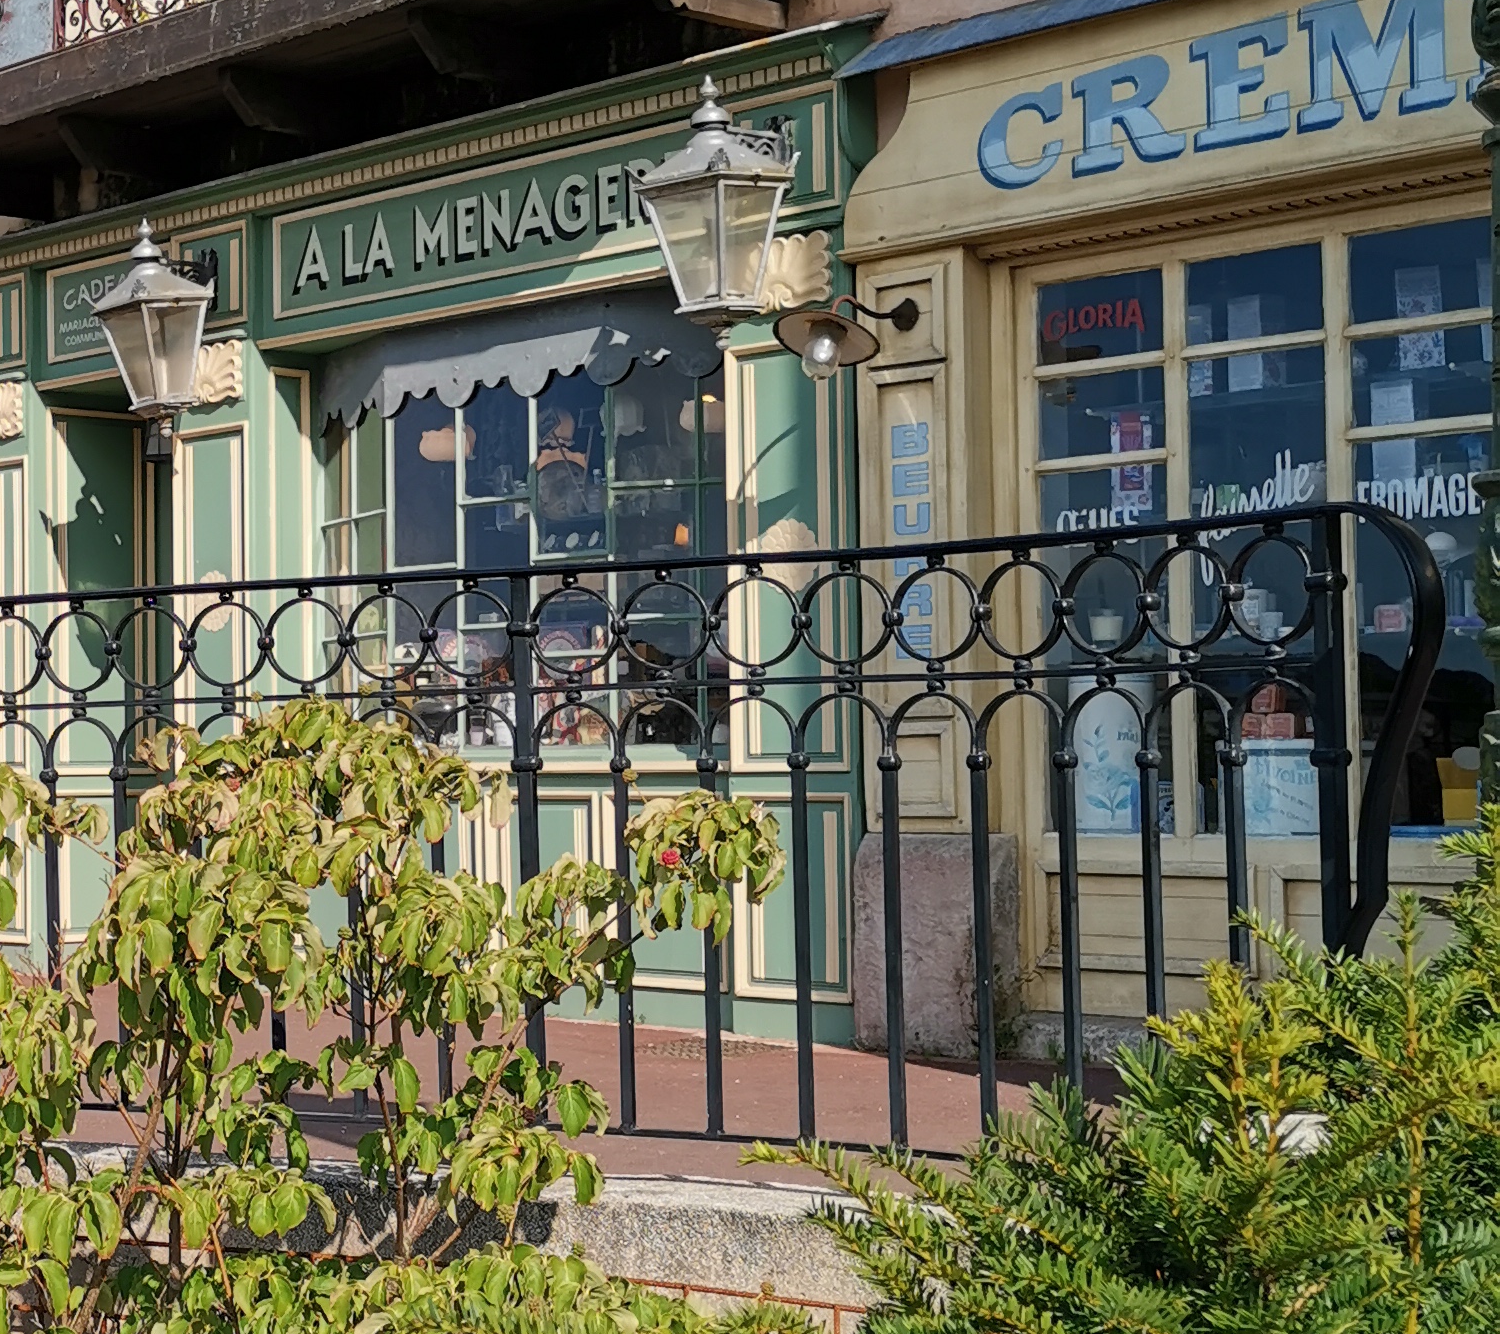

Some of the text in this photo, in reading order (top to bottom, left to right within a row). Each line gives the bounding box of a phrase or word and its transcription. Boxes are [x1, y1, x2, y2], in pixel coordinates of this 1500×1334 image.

[292, 152, 668, 296] A LA MENAGER
[1043, 298, 1145, 342] GLORIA
[1357, 472, 1488, 523] FROMAGE
